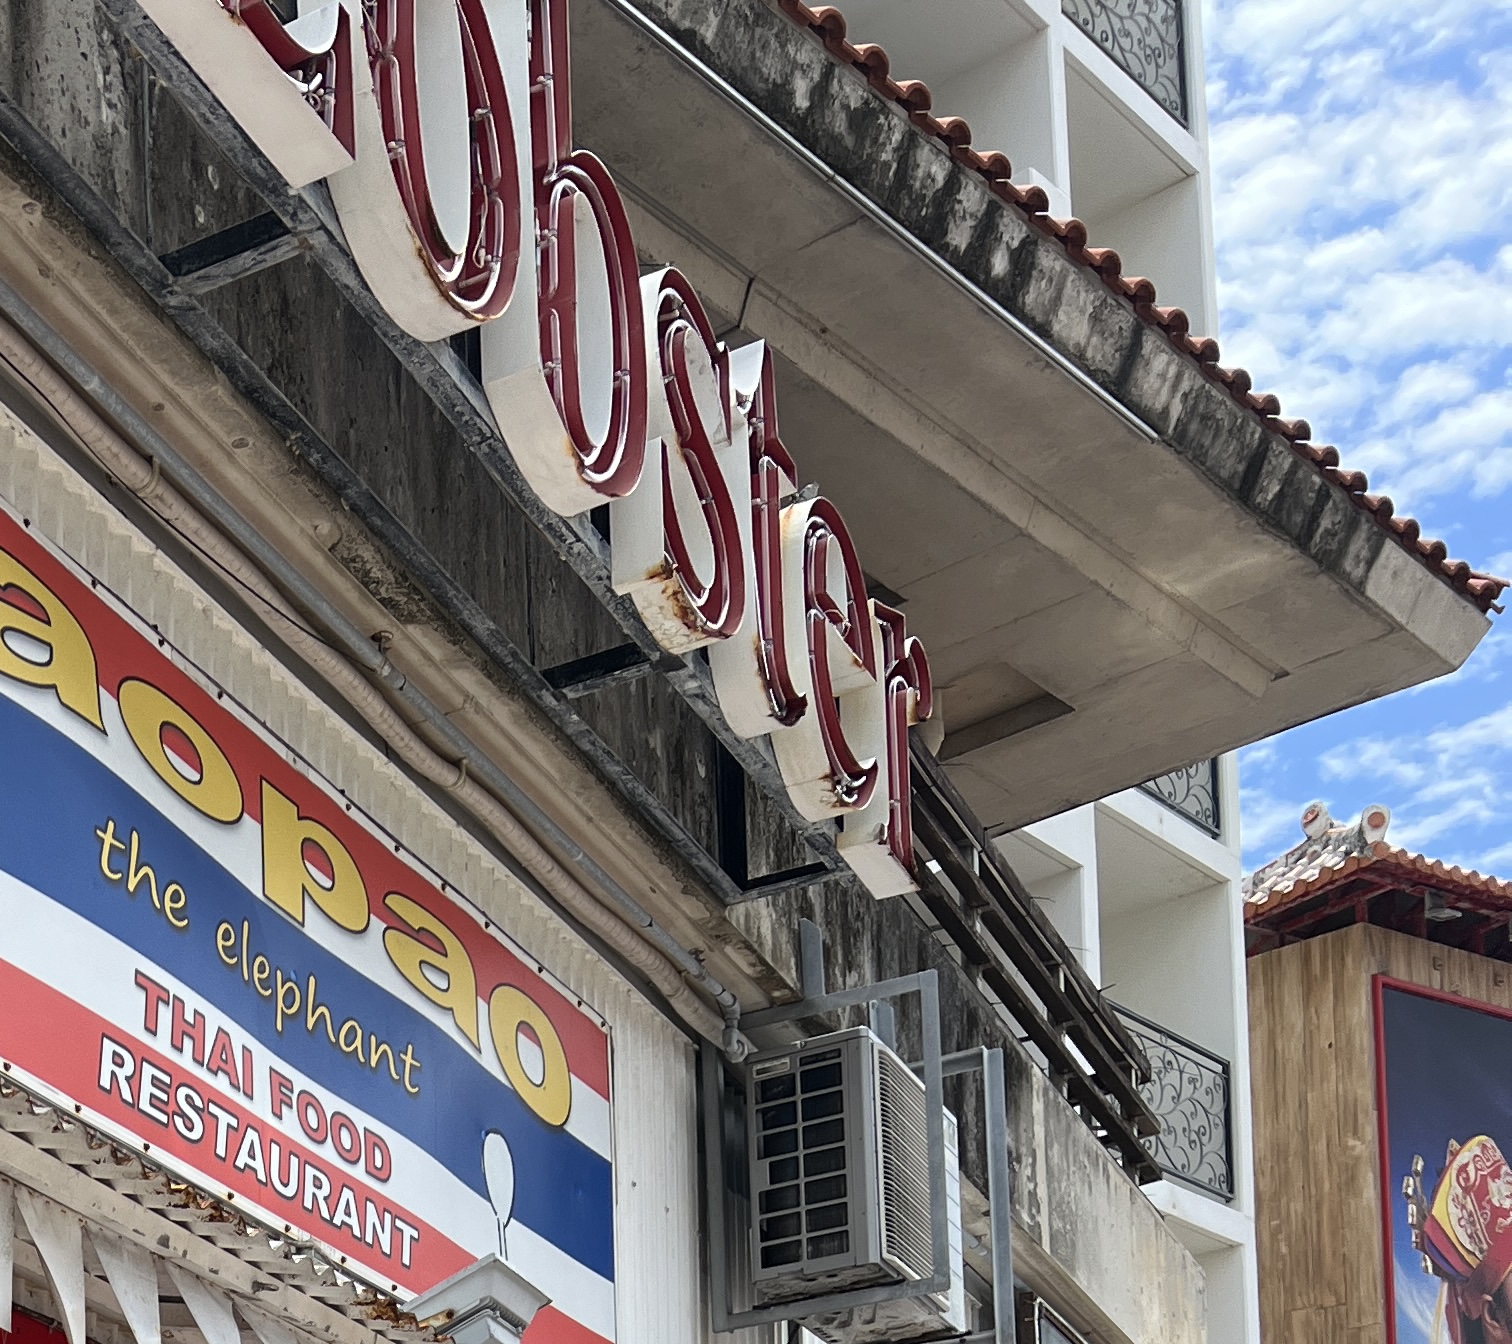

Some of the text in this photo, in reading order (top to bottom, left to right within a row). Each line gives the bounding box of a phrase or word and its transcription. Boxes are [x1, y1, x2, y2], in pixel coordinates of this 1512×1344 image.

[143, 0, 932, 898] obster
[94, 816, 422, 1093] the elephant
[134, 968, 392, 1183] THAI FOOD
[98, 1030, 420, 1267] RESTAURANT
